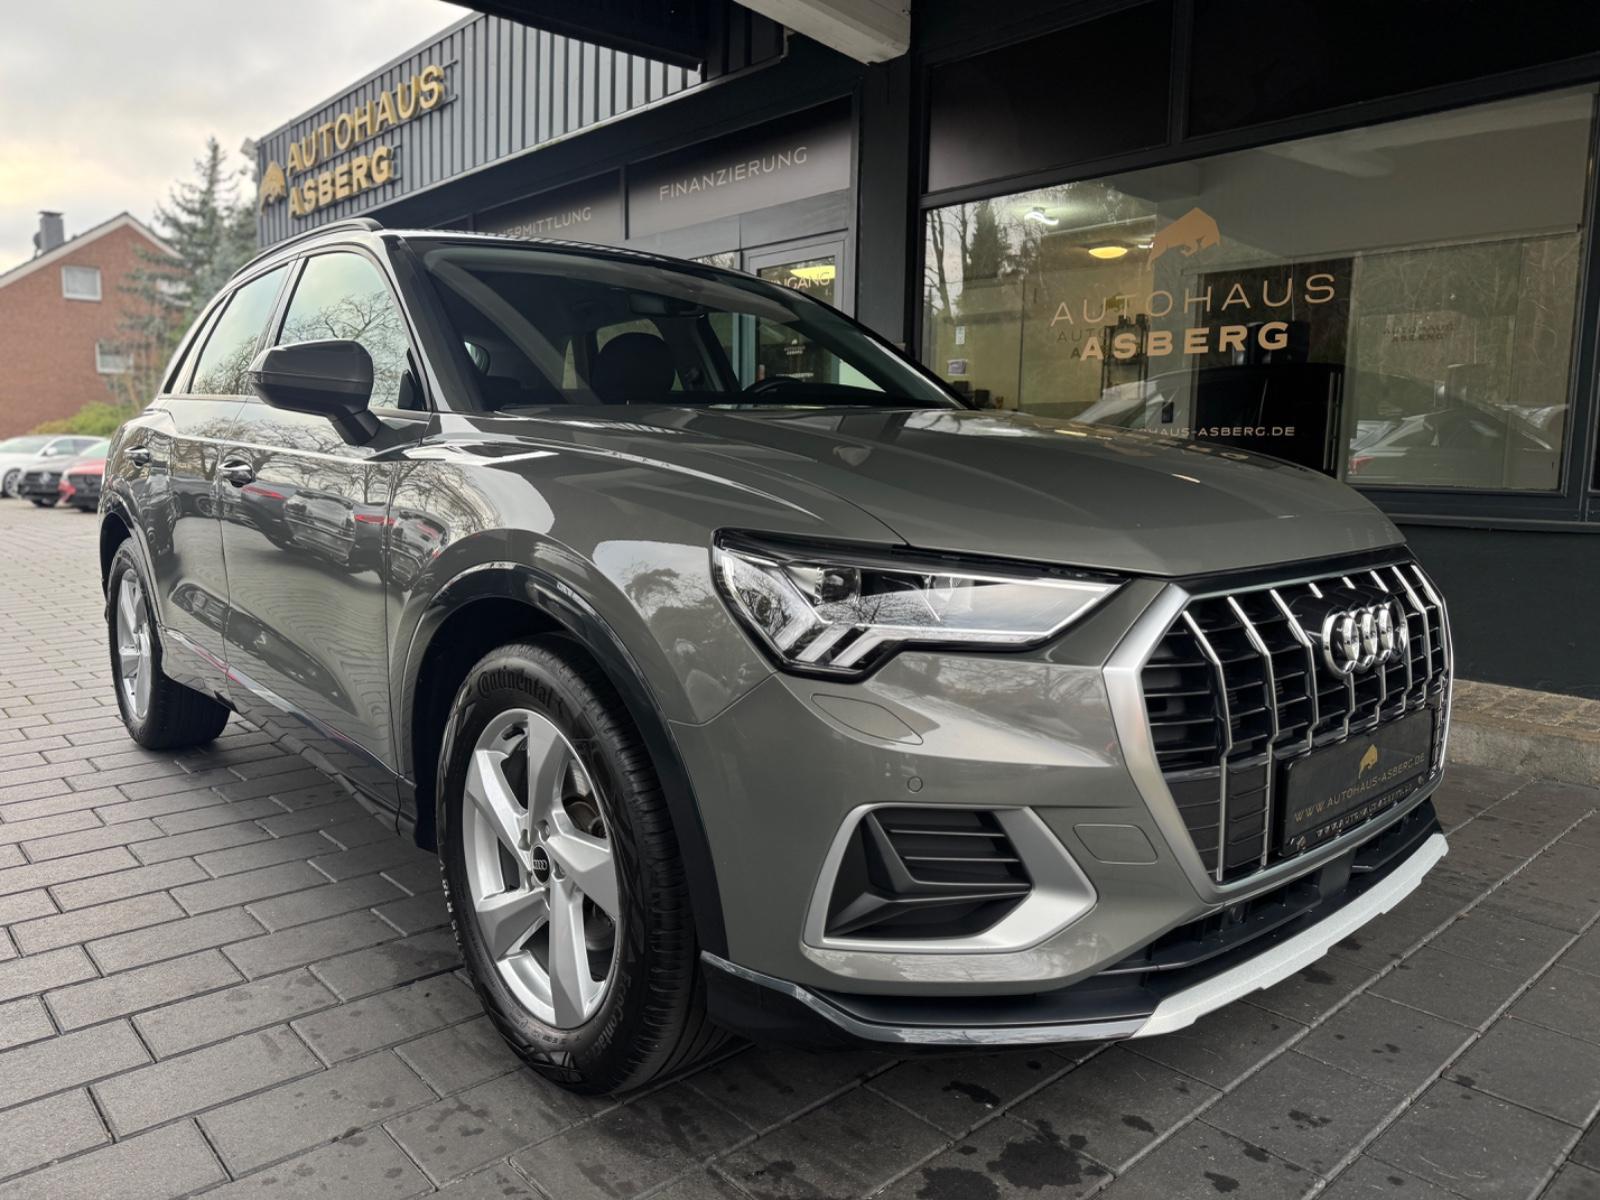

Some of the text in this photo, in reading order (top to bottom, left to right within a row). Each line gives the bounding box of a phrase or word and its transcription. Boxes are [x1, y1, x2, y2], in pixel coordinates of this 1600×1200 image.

[286, 64, 445, 177] AUTOHAUS
[288, 145, 394, 219] ASBERG
[659, 146, 808, 201] FINANZIERUNG
[1050, 273, 1335, 327] AUTOHAUS
[1080, 321, 1289, 361] ASBERG
[477, 665, 553, 708] Continental
